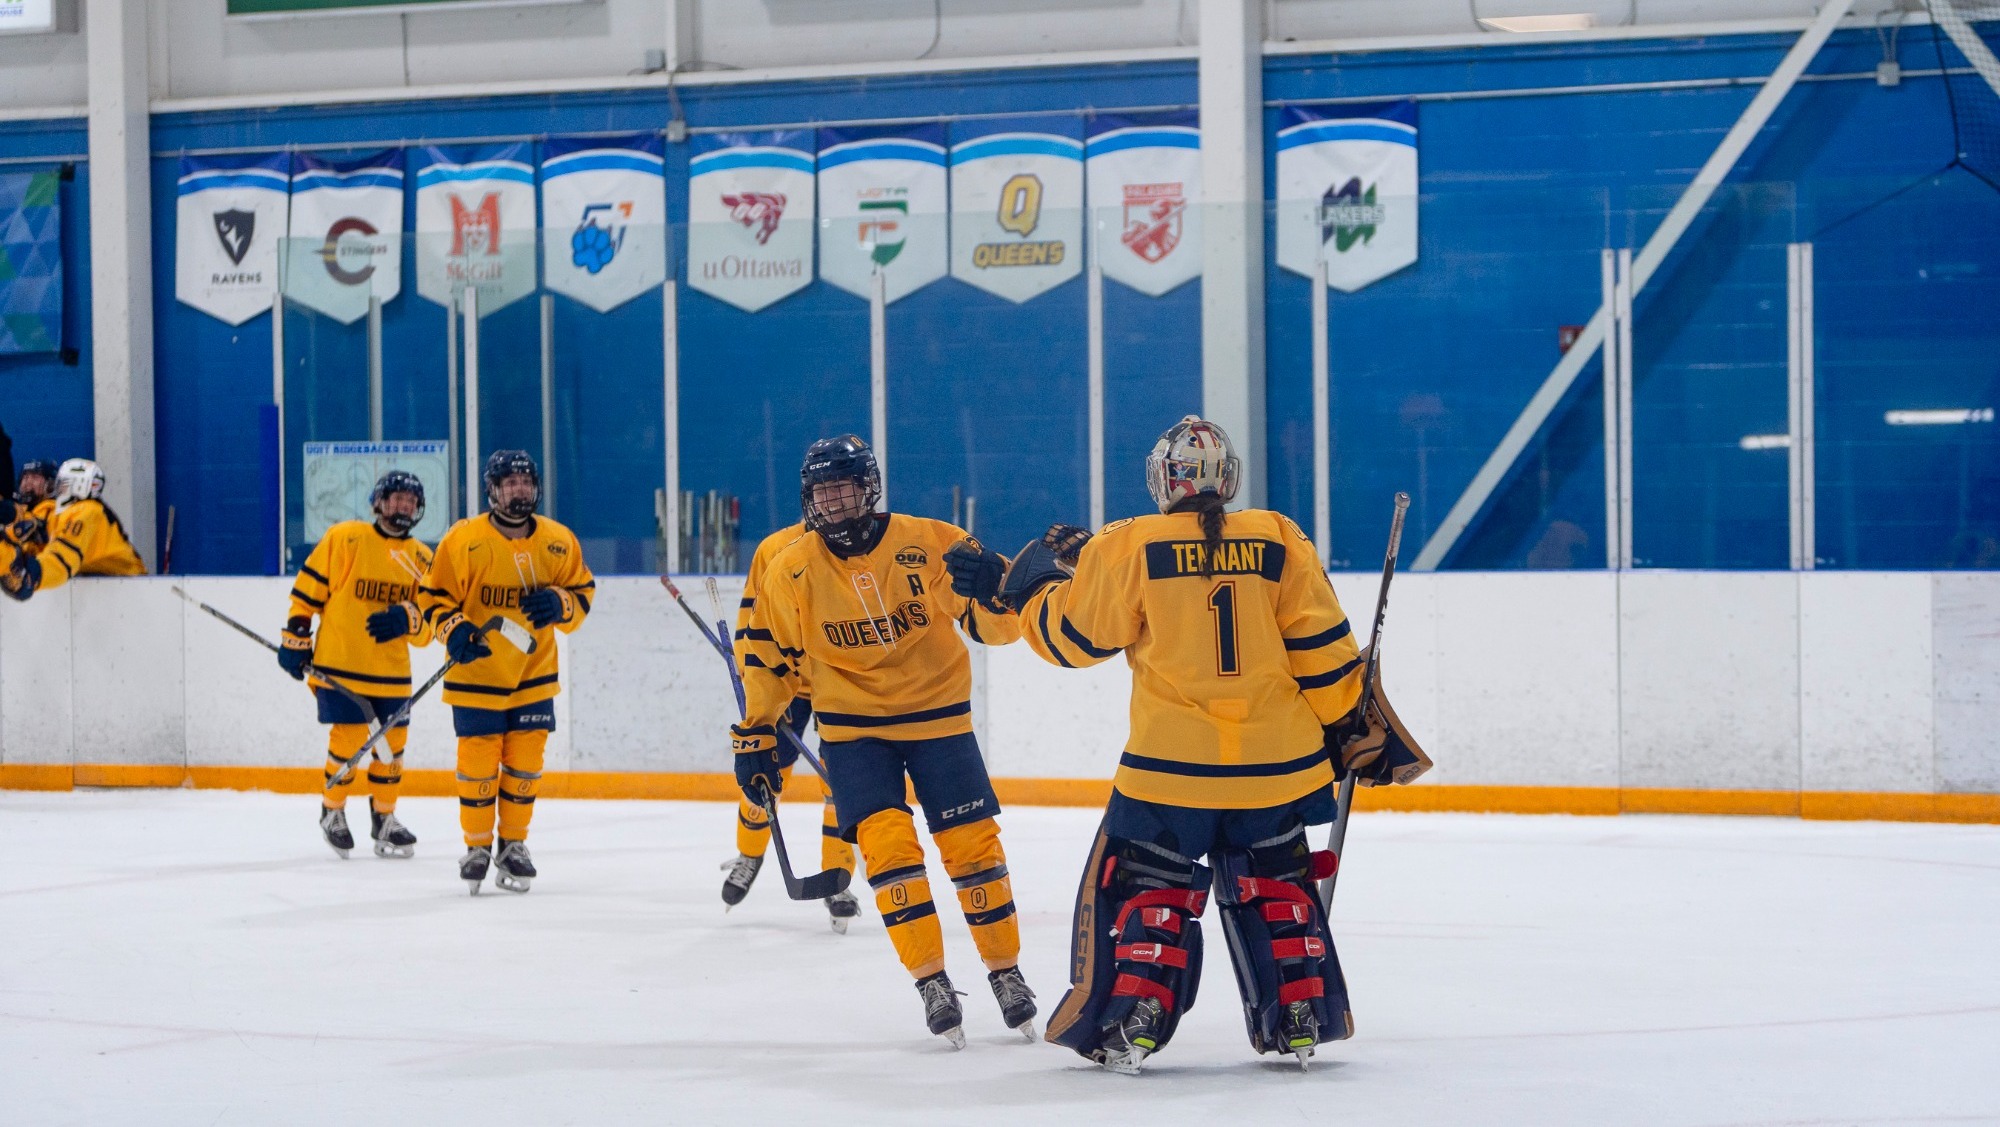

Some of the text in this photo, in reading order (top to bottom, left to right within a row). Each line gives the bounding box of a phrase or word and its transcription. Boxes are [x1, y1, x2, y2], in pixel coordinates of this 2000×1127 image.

[997, 173, 1043, 238] Q
[1315, 204, 1385, 225] LAKERS
[341, 245, 387, 256] STINGERS
[211, 271, 262, 284] RAVENS
[446, 261, 502, 280] McGill
[809, 461, 831, 470] CCM
[894, 553, 928, 565] OUA
[906, 573, 925, 597] A
[1207, 580, 1241, 677] 1
[519, 714, 551, 723] CCM
[732, 739, 761, 750] CM
[941, 798, 985, 820] CCM
[890, 882, 908, 907] Q
[970, 886, 988, 910] Q
[1074, 902, 1093, 984] CCM
